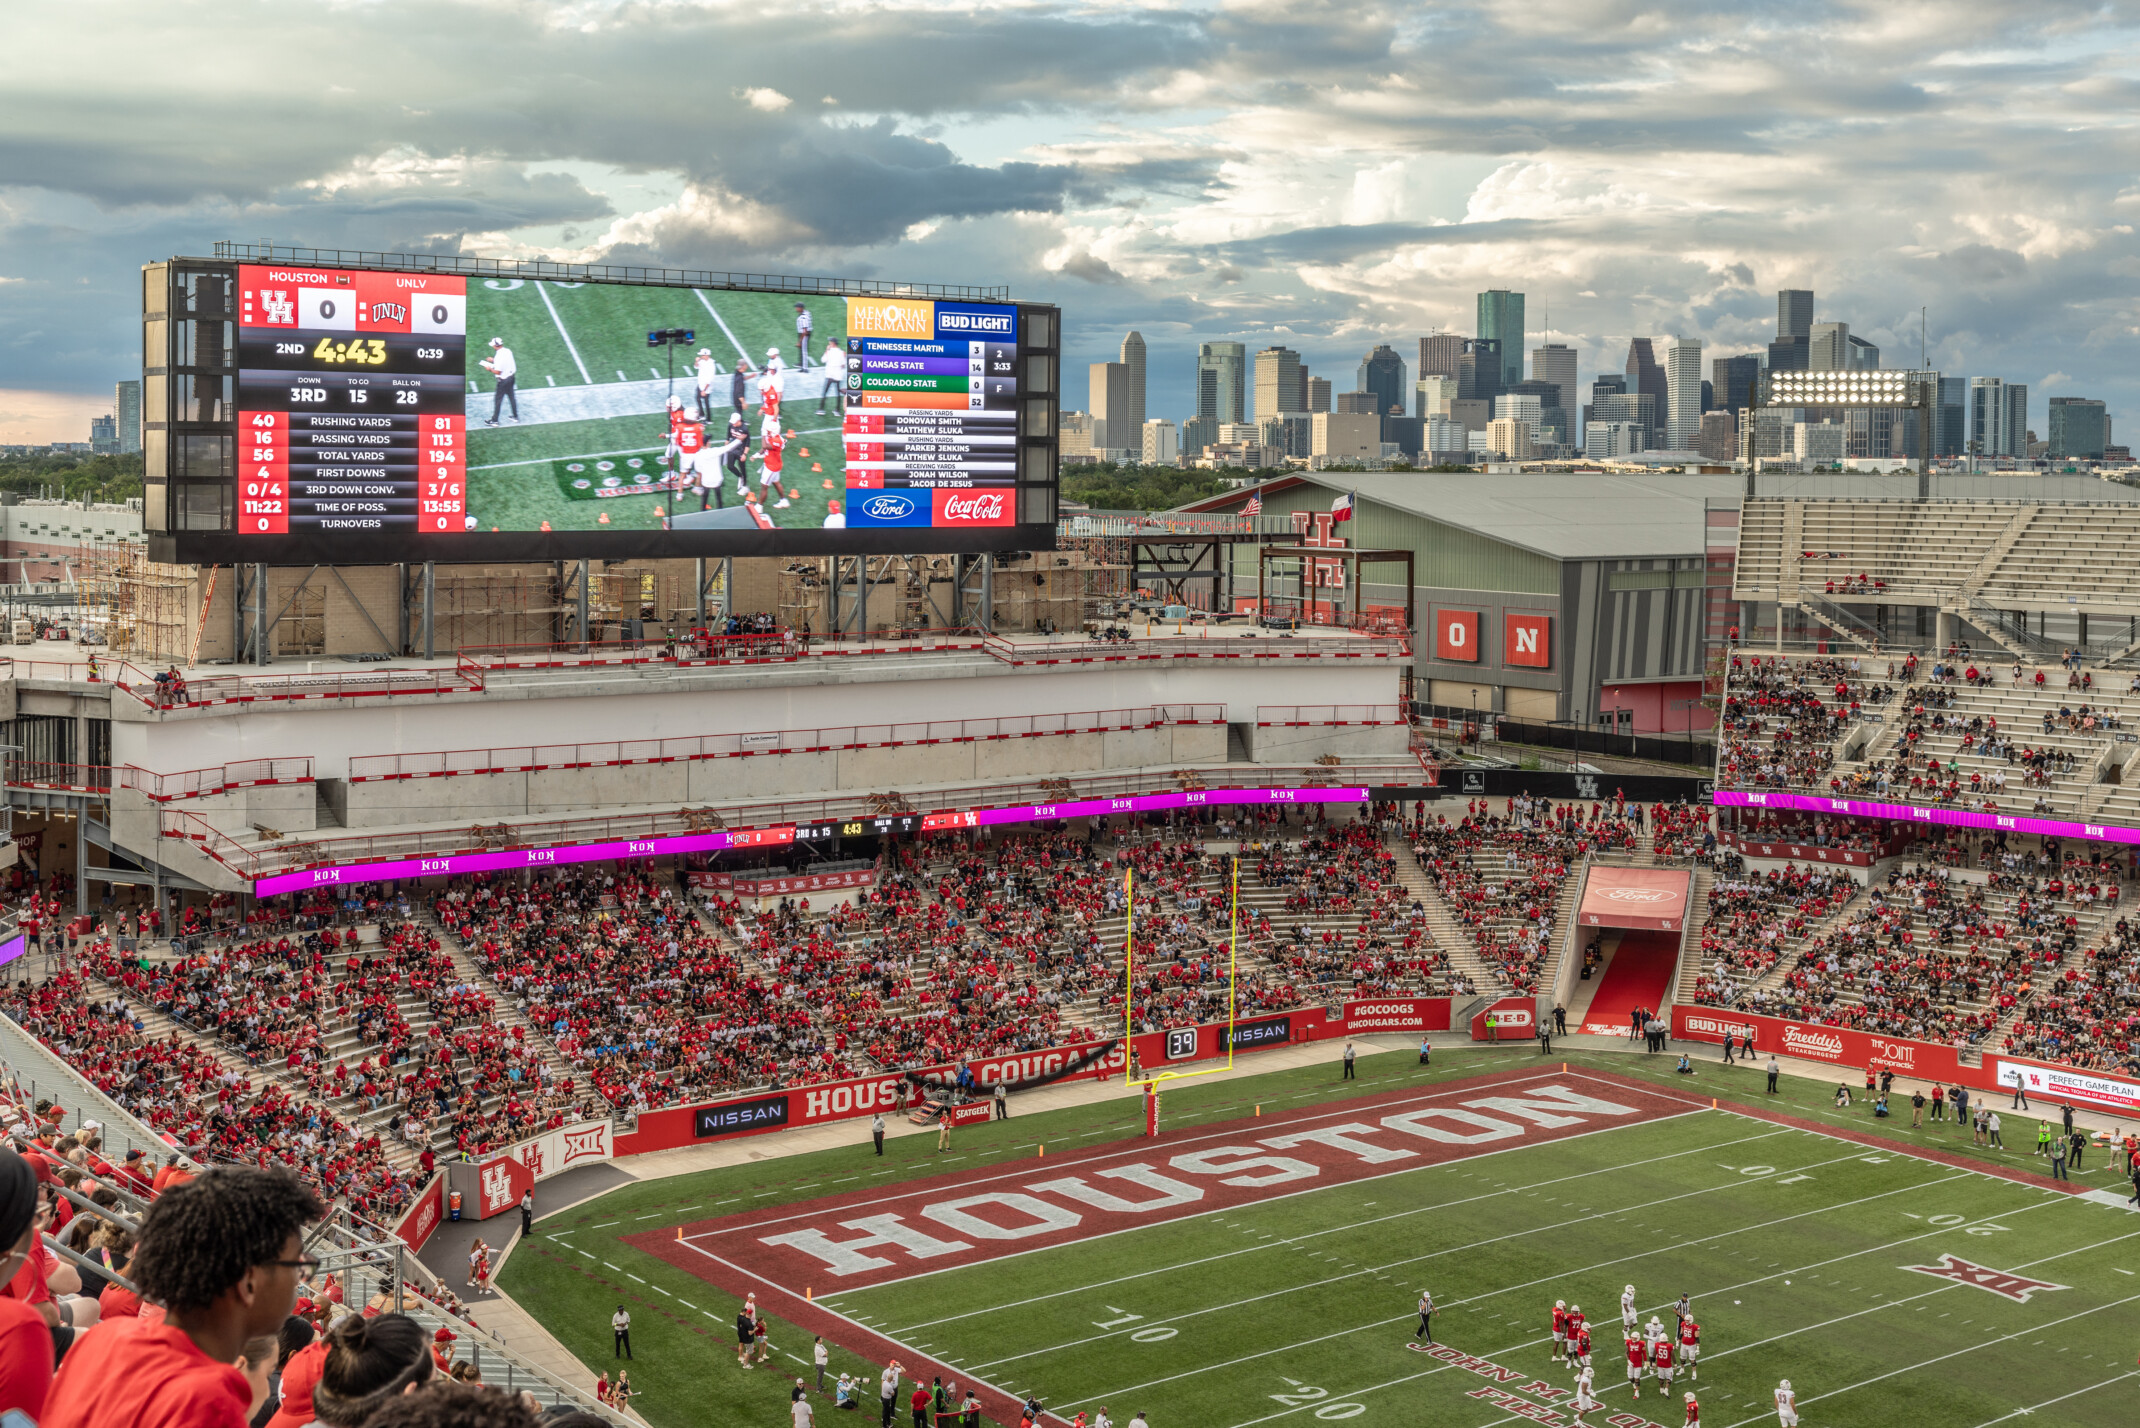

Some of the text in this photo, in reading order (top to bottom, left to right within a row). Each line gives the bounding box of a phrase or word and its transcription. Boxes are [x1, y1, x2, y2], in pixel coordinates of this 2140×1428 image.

[269, 271, 328, 284] HOUSTON
[396, 278, 427, 289] UNLV
[260, 290, 294, 324] UH
[319, 299, 336, 319] 0
[371, 302, 406, 325] UNLV
[431, 304, 448, 324] 0
[854, 305, 927, 322] MEMORIAL
[854, 318, 926, 333] HERMANN
[942, 315, 1010, 330] BUD LIGHT
[276, 343, 305, 354] 2ND
[313, 338, 386, 364] 4:43
[417, 348, 444, 359] 0:39
[867, 343, 912, 352] TENNESSEE
[996, 350, 1003, 358] 2
[867, 360, 925, 370] KANSAS STATE
[972, 364, 981, 372] 14
[867, 378, 937, 388] COLORADO STATE
[974, 381, 980, 389] 0
[996, 385, 1003, 393] F
[291, 388, 326, 402] 3RD
[349, 389, 367, 403] 15
[396, 391, 418, 404] 28
[867, 396, 892, 404] TEXAS
[972, 398, 981, 406] 52
[252, 414, 275, 427] 40
[311, 417, 391, 427] RUSHING YARDS
[435, 417, 451, 430] 81
[860, 416, 868, 424] 16
[897, 417, 936, 425] DONOVAN
[938, 427, 963, 435] SLUKA
[255, 432, 272, 444] 16
[312, 435, 390, 445] PASSING YARDS
[432, 434, 453, 446] 113
[860, 444, 868, 452] 17
[905, 445, 970, 453] PARKER JENKINS
[253, 449, 274, 461] 56
[318, 452, 385, 461] TOTAL YARDS
[429, 450, 455, 463] 194
[859, 453, 868, 461] 39
[257, 466, 269, 478] 4
[317, 469, 386, 478] FIRST DOWNS
[437, 467, 447, 480] 9
[859, 480, 868, 488] 42
[910, 480, 973, 488] JACOB DE JESUS
[306, 486, 396, 495] 3RD DOWN CONV.
[245, 501, 282, 513] 11:22
[315, 503, 386, 512] TIME OF POSS.
[423, 501, 461, 513] 13:55
[870, 498, 905, 516] Ford
[258, 518, 269, 531] 0
[321, 519, 381, 529] TURNOVERS
[437, 517, 447, 530] 0
[1449, 622, 1538, 653] O N
[822, 827, 831, 836] 15
[843, 823, 862, 835] 4:43
[1610, 889, 1663, 902] Ford
[1354, 1004, 1414, 1016] #GOCOOGS
[1347, 1017, 1423, 1029] UHCOUGARS.COM
[1689, 1018, 1755, 1039] BUD LIGH
[1227, 1024, 1285, 1044] NISSAN
[1782, 1026, 1843, 1050] Freddy's
[1173, 1033, 1193, 1055] 39
[1871, 1039, 1884, 1049] THE
[1788, 1046, 1840, 1060] STEAKBURGERS
[1870, 1057, 1915, 1070] chiropractic
[2049, 1074, 2134, 1097] PERFECT GAME PLAN
[2050, 1085, 2070, 1094] OFFICIAL
[2071, 1089, 2090, 1098] TEQUILA
[2108, 1095, 2133, 1105] ATHLETICS
[704, 1104, 781, 1129] NISSAN
[955, 1104, 990, 1120] SEATGEEK
[482, 1162, 513, 1211] UH
[757, 1085, 1641, 1277] HOUSTON
[1406, 1342, 1528, 1383] JOHN
[1466, 1392, 1597, 1428] FIEL
